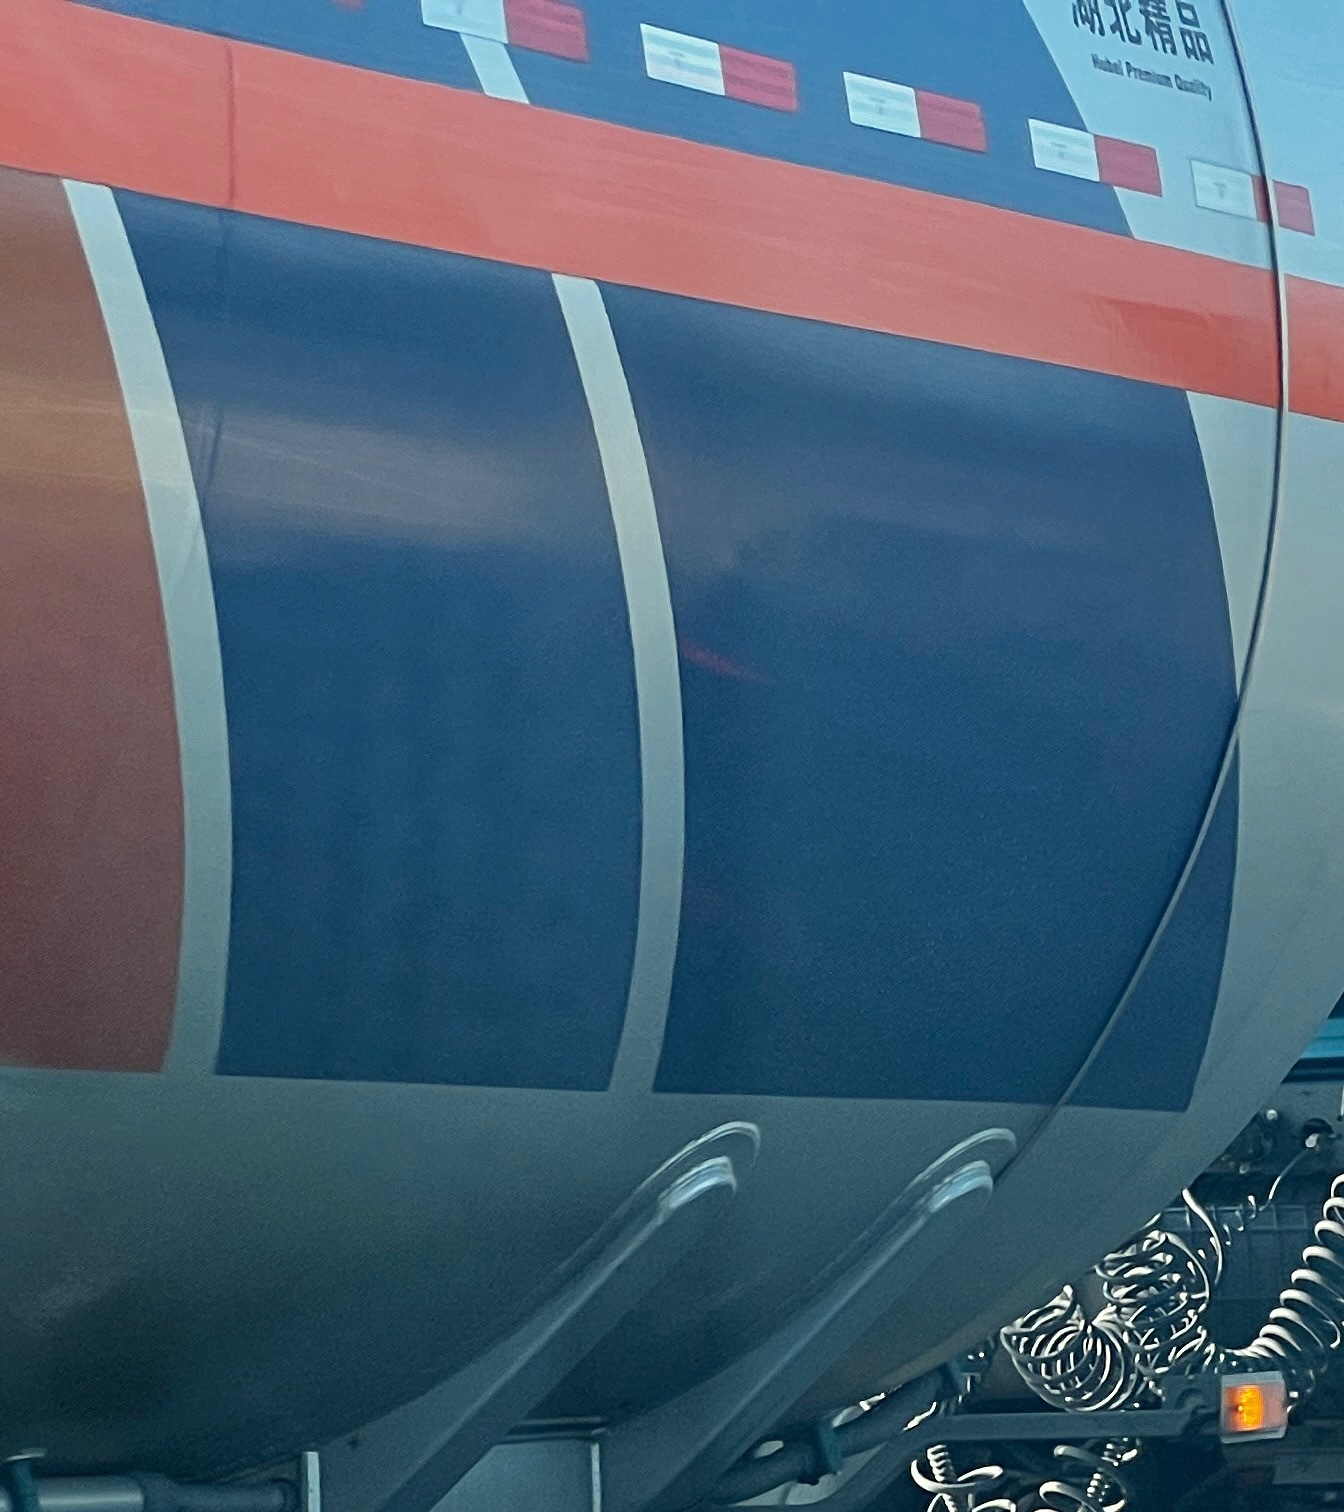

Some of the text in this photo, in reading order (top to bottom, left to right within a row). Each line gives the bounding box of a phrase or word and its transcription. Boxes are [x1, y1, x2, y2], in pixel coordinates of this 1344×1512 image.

[1072, 0, 1214, 64] 湖北精品
[1091, 53, 1212, 101] Hubei Premium Quality
